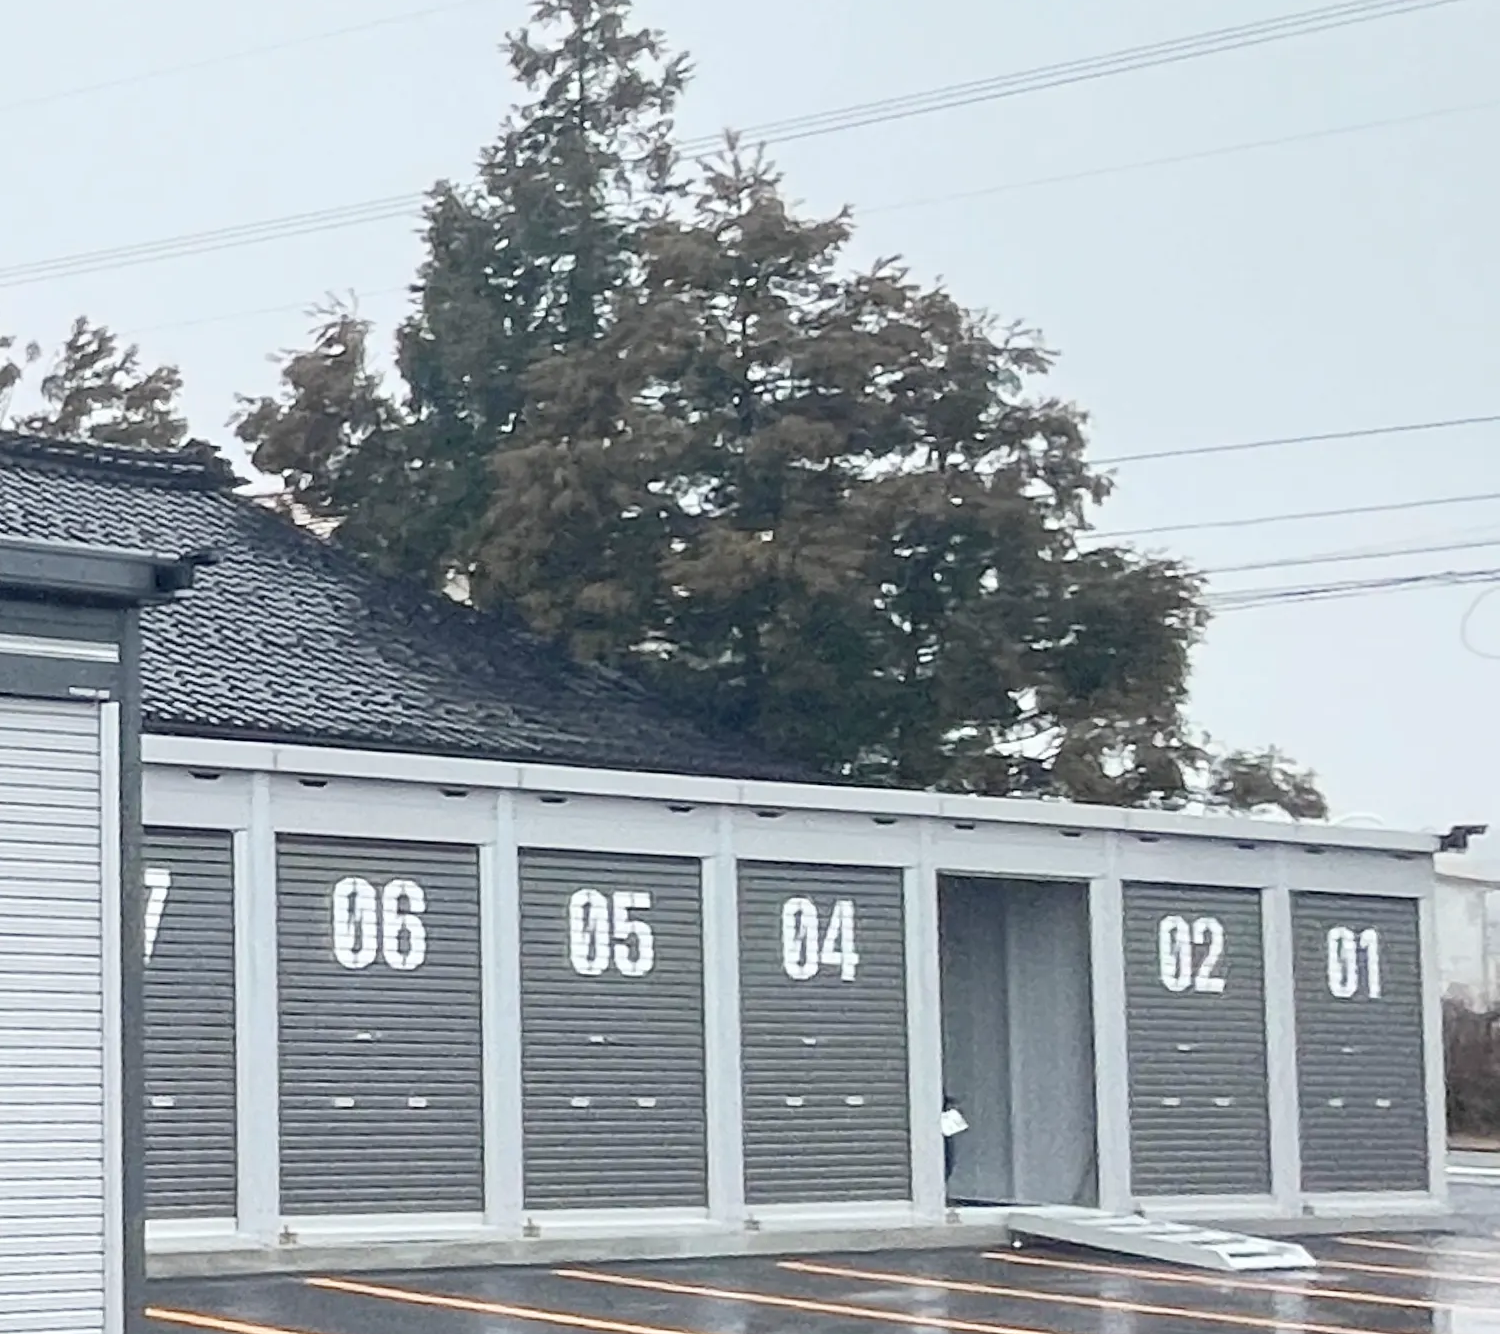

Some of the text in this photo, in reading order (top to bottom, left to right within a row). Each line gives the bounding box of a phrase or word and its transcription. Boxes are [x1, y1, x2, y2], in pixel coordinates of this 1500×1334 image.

[332, 877, 427, 970] 06
[568, 888, 655, 977] 05
[781, 897, 860, 982] 04
[1159, 915, 1226, 994] 02
[1327, 926, 1382, 999] 01
